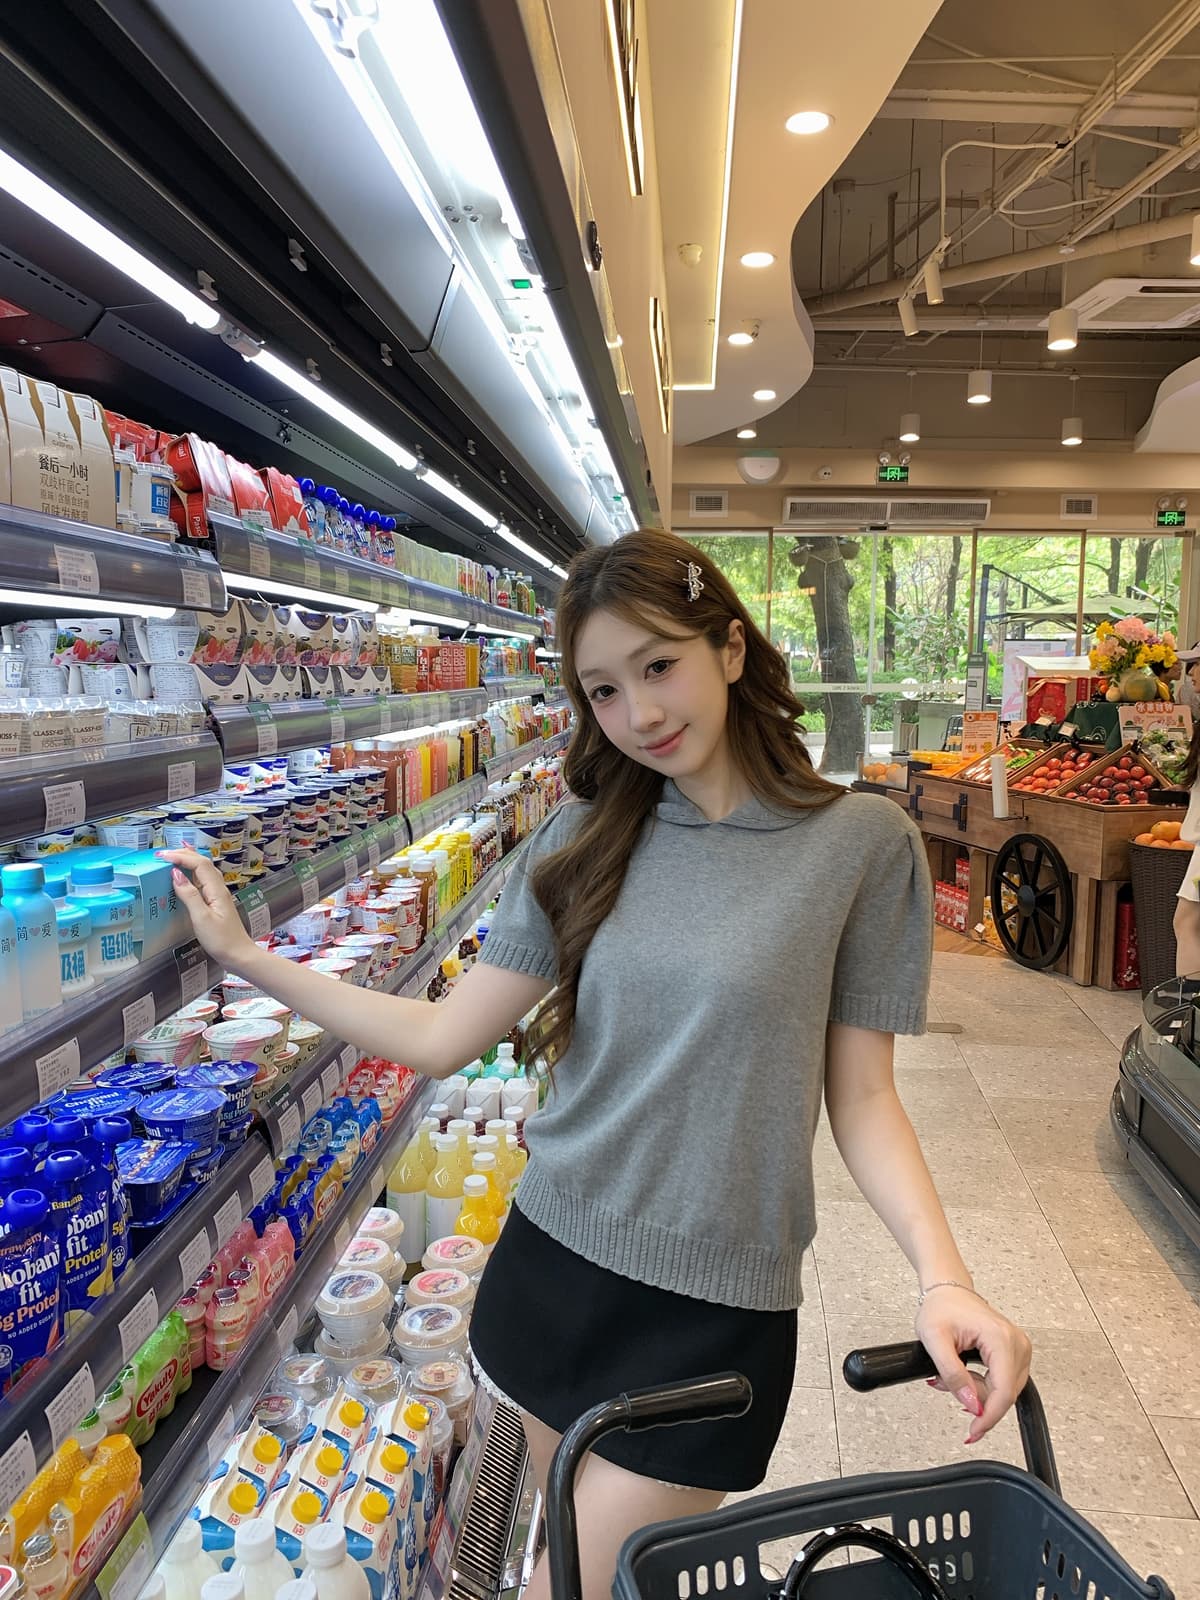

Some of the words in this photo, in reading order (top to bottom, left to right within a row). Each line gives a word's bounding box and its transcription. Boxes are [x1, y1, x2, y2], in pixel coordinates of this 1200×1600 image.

[39, 454, 88, 481] 餐后一小时
[66, 1234, 89, 1258] fit
[0, 1244, 60, 1291] hobani
[18, 1280, 43, 1306] fit
[8, 1331, 17, 1339] NO
[18, 1322, 38, 1335] ADDED
[142, 1368, 173, 1408] Yakult
